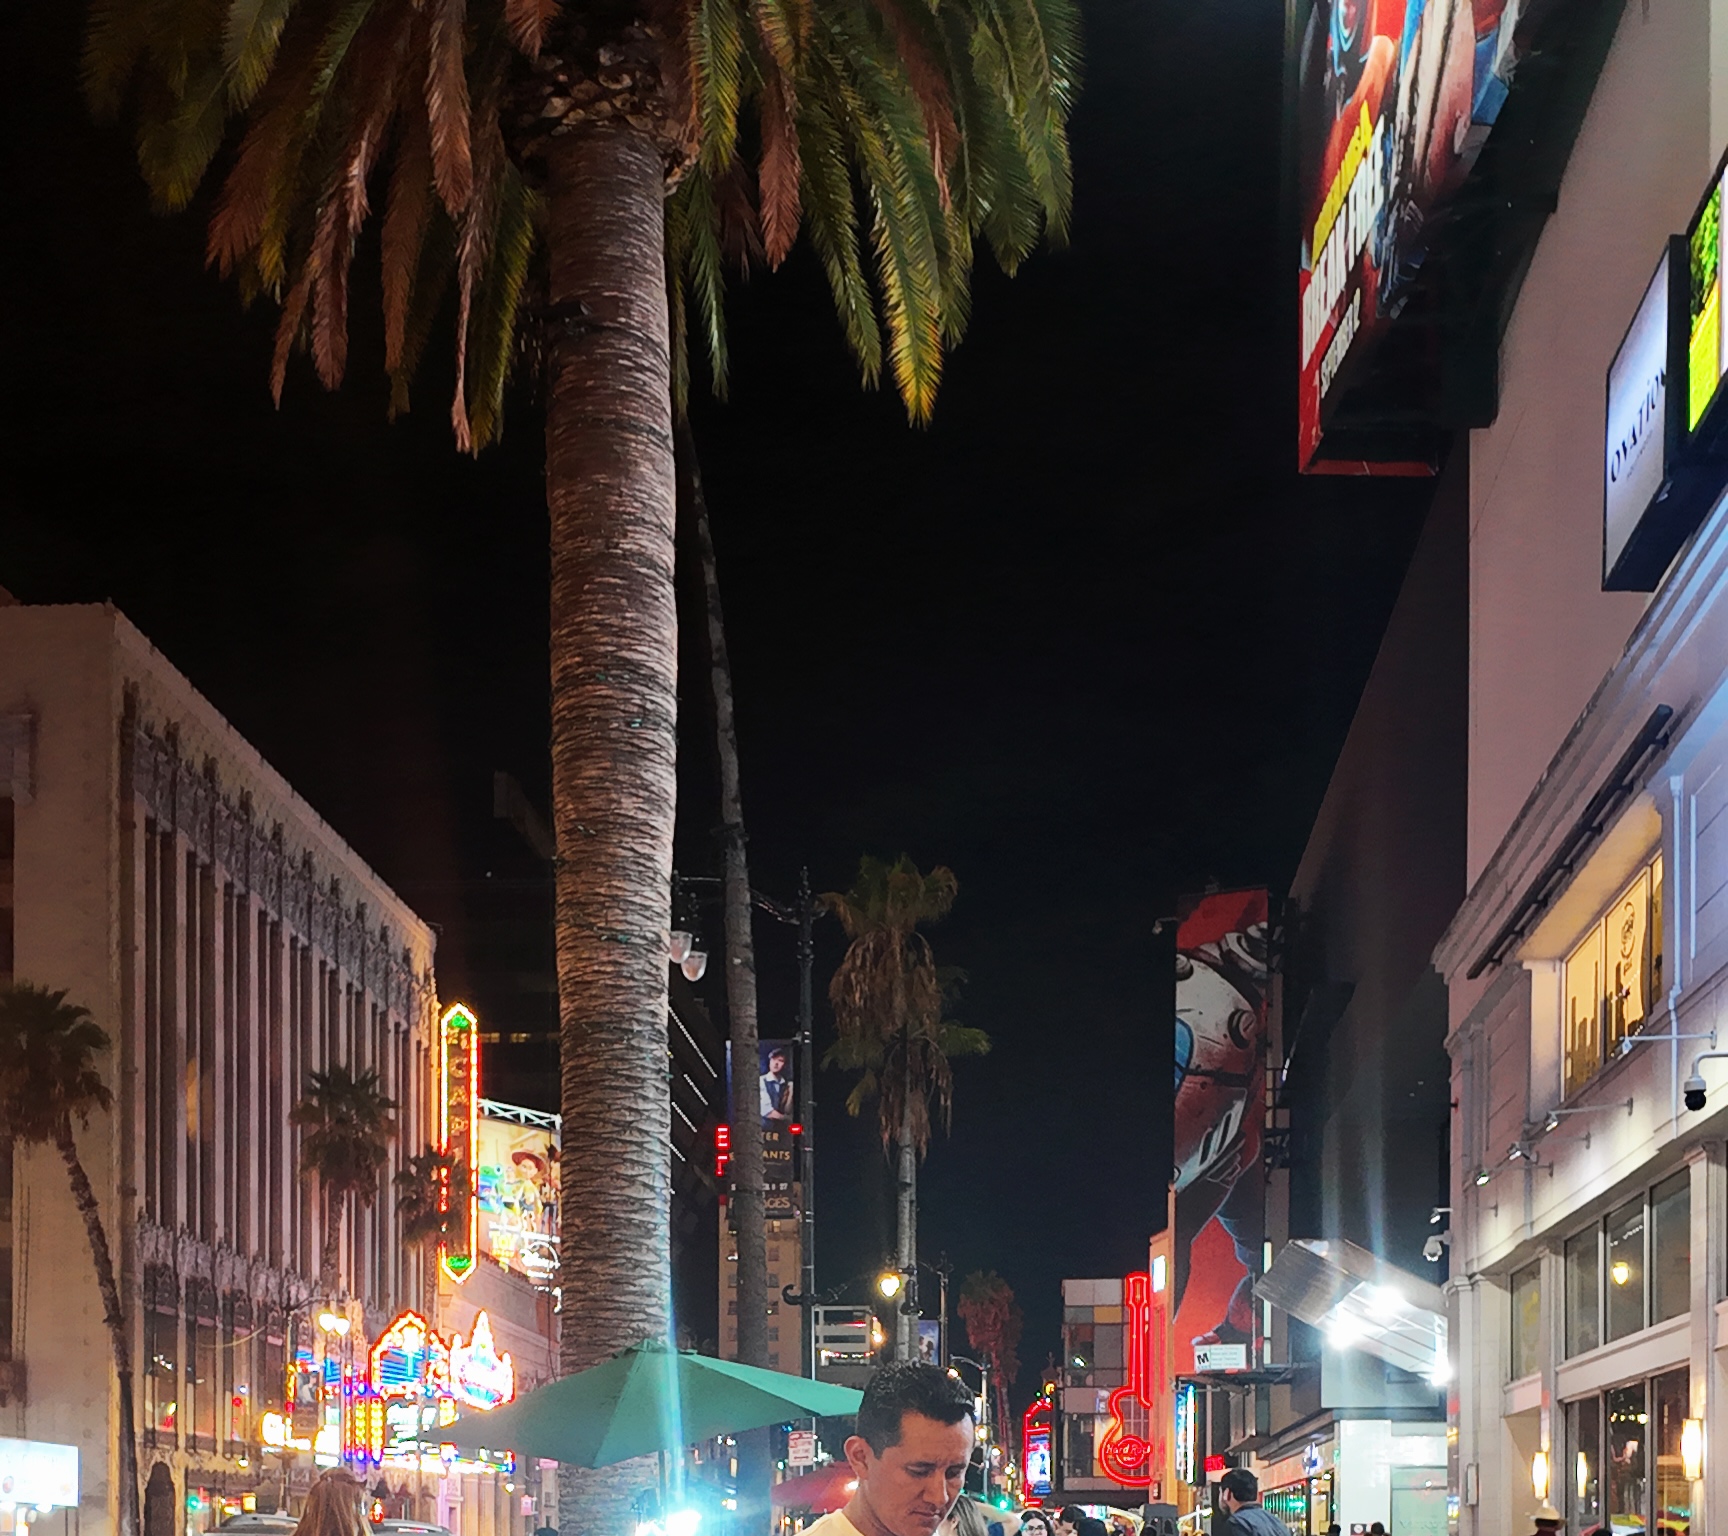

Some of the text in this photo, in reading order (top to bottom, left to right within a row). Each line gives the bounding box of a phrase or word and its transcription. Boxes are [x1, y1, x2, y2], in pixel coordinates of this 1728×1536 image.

[1302, 202, 1347, 371] BREAK
[1348, 114, 1386, 271] FREE
[1197, 1353, 1209, 1365] M
[1105, 1443, 1130, 1454] Hard
